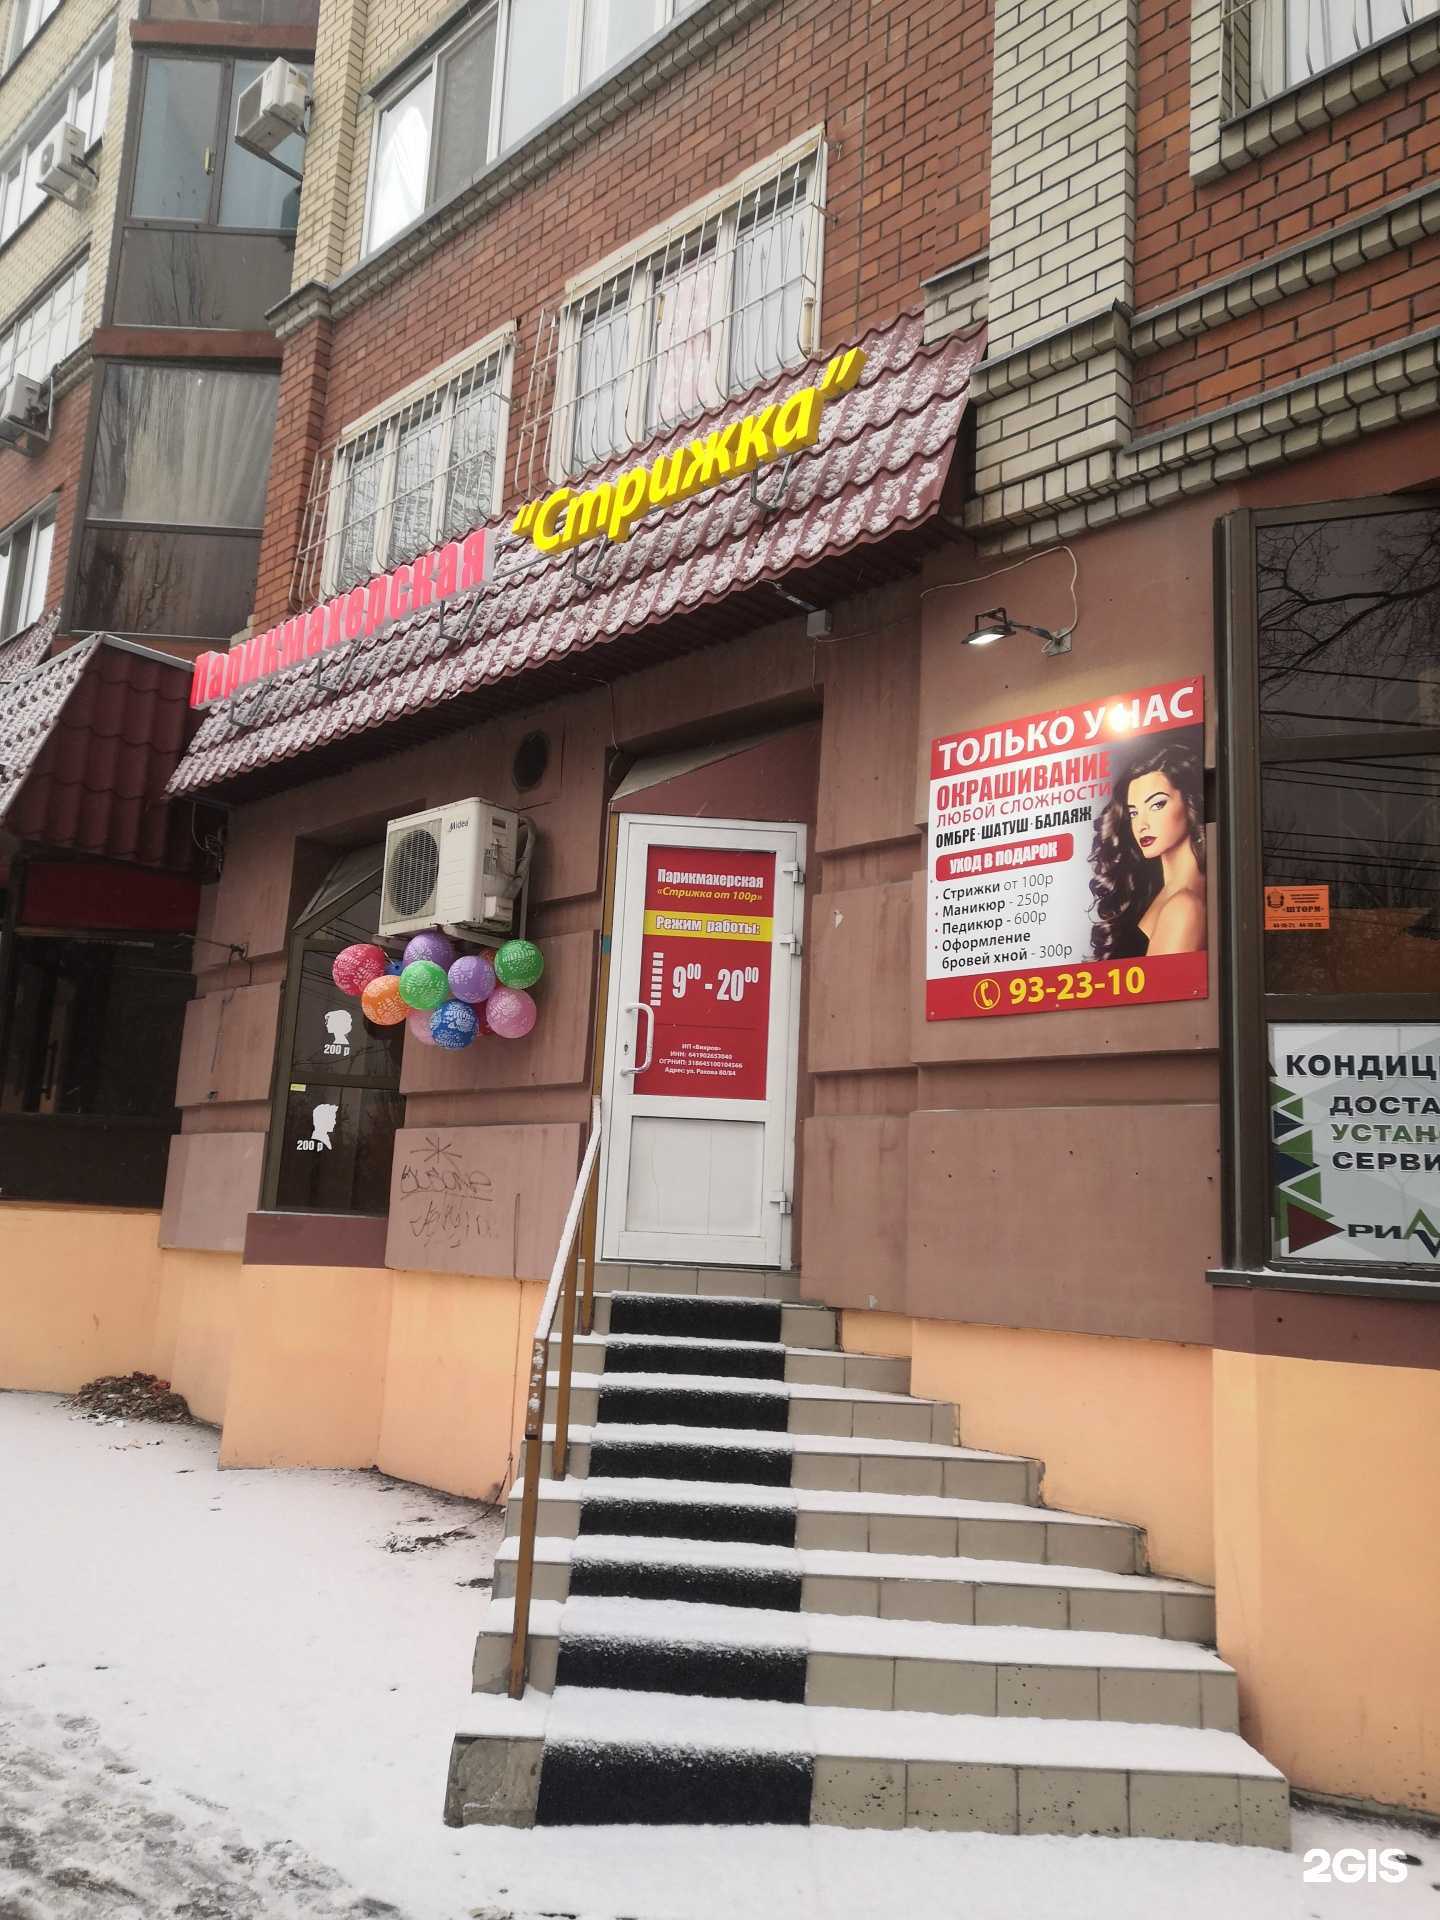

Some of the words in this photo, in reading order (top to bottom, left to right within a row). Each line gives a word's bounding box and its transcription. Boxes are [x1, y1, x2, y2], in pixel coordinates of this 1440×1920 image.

[190, 528, 493, 709] Парикмахерская
[939, 716, 1075, 771] ТОЛЬКО
[1083, 706, 1106, 741] У
[937, 751, 1112, 811] ОКРАШИВАНИЕ
[937, 803, 996, 828] ЛЮБОЙ
[1000, 783, 1113, 815] СЛОЖНОСТИ
[1035, 806, 1092, 829] БАЛАЯЖ
[949, 855, 982, 874] УХОД
[984, 852, 993, 866] В
[995, 841, 1058, 865] ПОДАРОК
[657, 868, 764, 888] Парикмахерская
[942, 882, 1000, 901] Стрижки
[1003, 879, 1017, 890] от
[1022, 873, 1054, 888] 100р
[657, 886, 713, 899] «Стрижка
[714, 891, 730, 899] от
[733, 891, 762, 902] 100р»
[942, 899, 1006, 917] Маникюр
[1017, 892, 1049, 907] 250р
[656, 915, 702, 931] Режим
[706, 920, 761, 935] работы:
[942, 918, 1003, 936] Педикюр
[1014, 910, 1047, 925] 600р
[942, 931, 1031, 952] Оформление
[942, 955, 990, 971] бровей
[993, 947, 1027, 964] хной
[1039, 944, 1073, 959] 300р
[1009, 966, 1145, 1005] 93-23-10
[323, 1044, 341, 1055] 200
[343, 1046, 350, 1056] р
[1286, 1054, 1440, 1081] КОНДИЦ
[296, 1140, 315, 1151] 200
[317, 1142, 324, 1152] р
[1331, 1123, 1440, 1143] УСТАН
